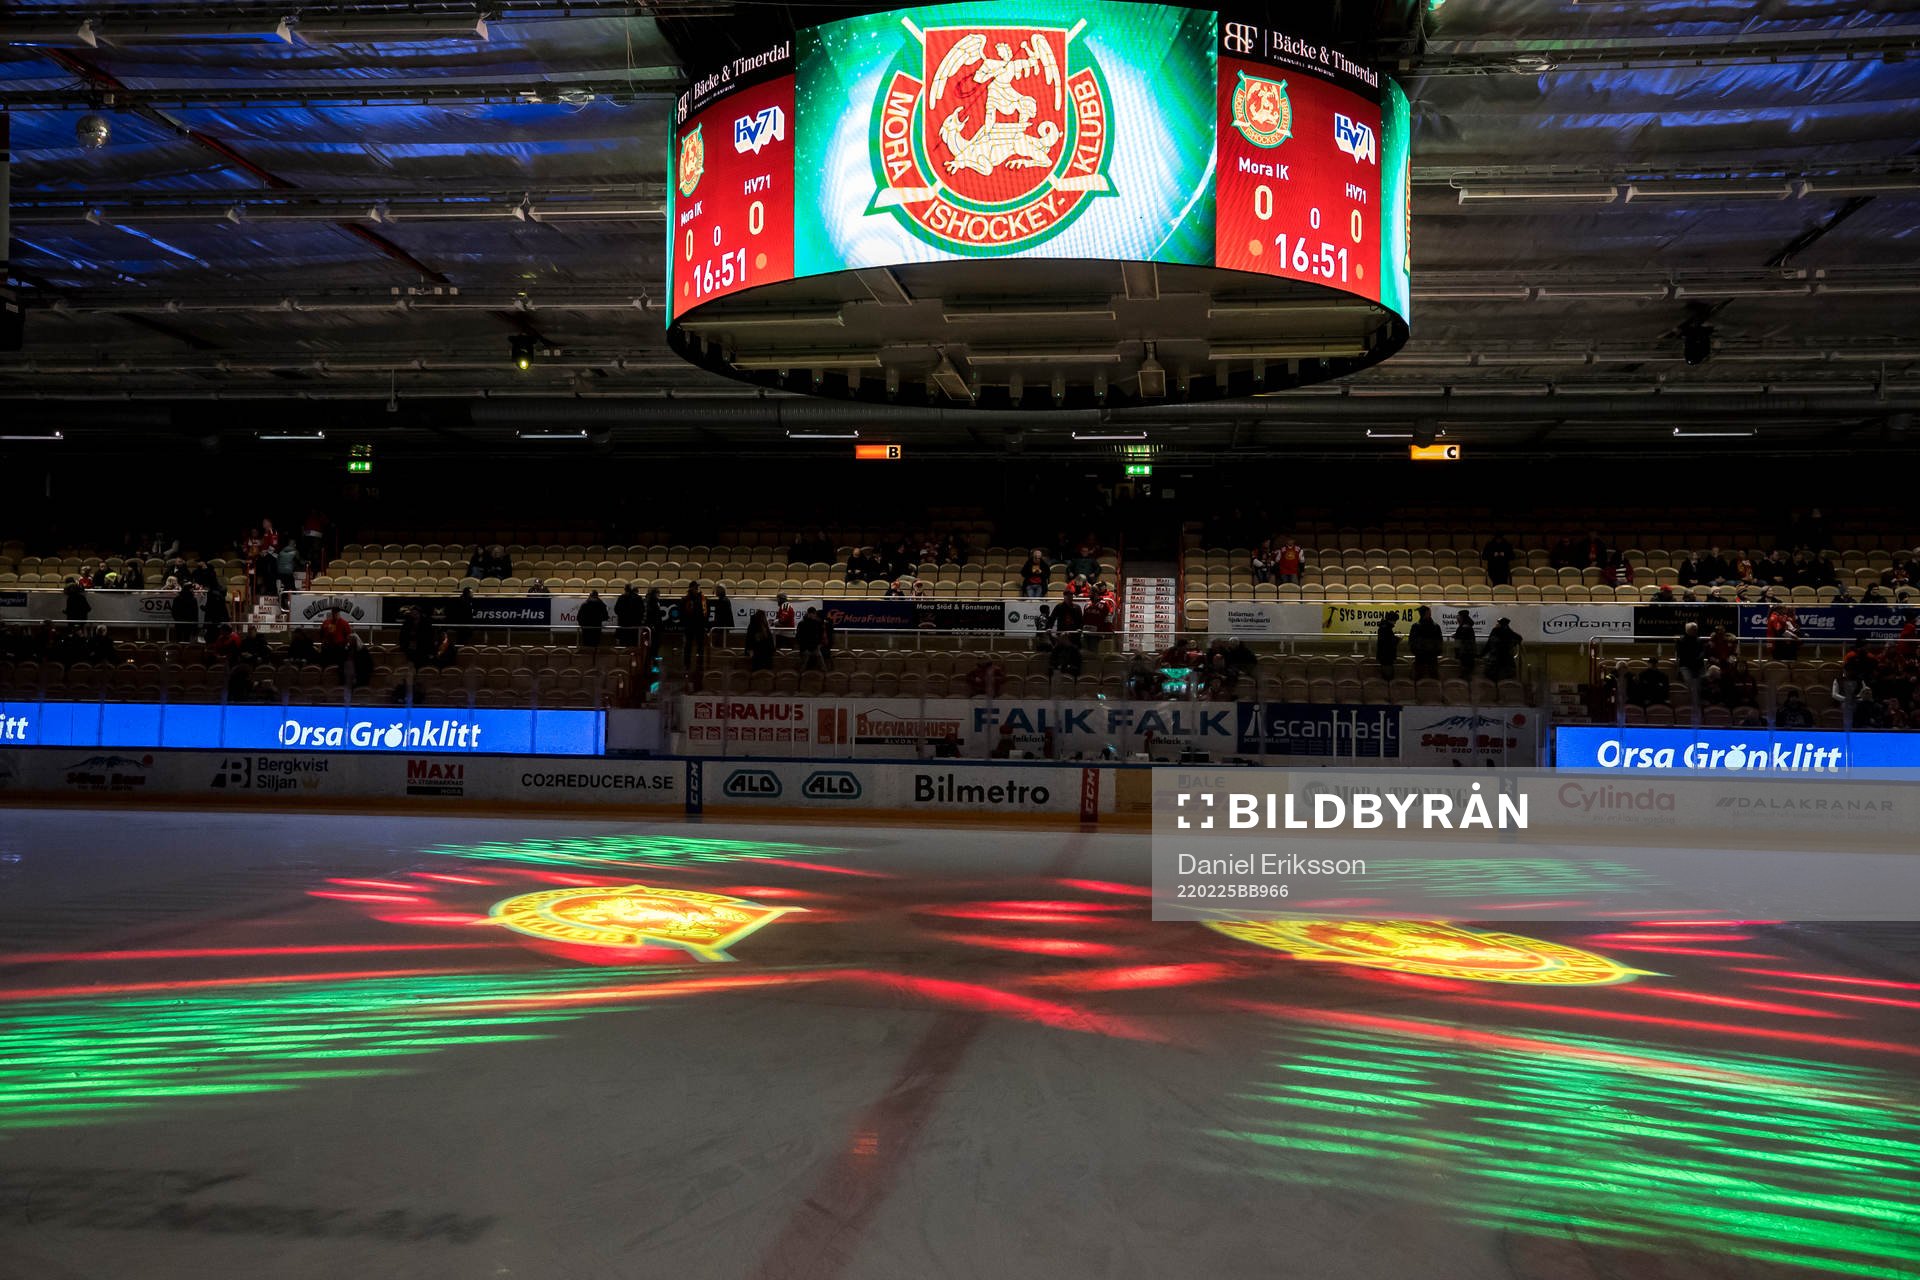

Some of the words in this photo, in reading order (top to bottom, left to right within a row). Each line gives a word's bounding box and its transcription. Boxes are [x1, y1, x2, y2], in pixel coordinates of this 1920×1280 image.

[694, 72, 720, 101] Bäcke
[721, 65, 731, 82] &
[732, 40, 790, 77] Timerdal
[1272, 31, 1317, 60] Bäcke
[1319, 46, 1330, 65] &
[1332, 50, 1379, 88] Timerdal
[884, 91, 914, 182] MORA
[1072, 78, 1103, 173] KLUBB
[1238, 157, 1273, 178] Mora
[1276, 163, 1290, 181] IK
[744, 174, 771, 196] HV71
[1345, 182, 1367, 205] HV71
[680, 208, 694, 227] Mora
[694, 200, 704, 215] IK
[1254, 185, 1273, 221] 0
[748, 200, 765, 236] 0
[1310, 207, 1321, 230] 0
[1351, 209, 1363, 244] 0
[685, 229, 694, 262] 0
[713, 225, 722, 247] 0
[1274, 233, 1349, 283] 16:51
[693, 247, 747, 298] 16:51
[888, 446, 899, 458] B
[1447, 446, 1457, 458] C
[1340, 608, 1355, 622] SYS
[1402, 608, 1413, 622] AB
[1800, 614, 1836, 628] Vägg
[716, 703, 804, 720] BRAHUS
[974, 708, 1096, 734] FALK
[1107, 708, 1232, 736] FALK
[279, 720, 342, 747] Orsa
[1272, 718, 1397, 739] scanmast
[258, 757, 328, 775] Bergkvist
[1597, 740, 1675, 768] Orsa
[257, 774, 297, 792] Siljan
[408, 760, 464, 779] MAXI
[521, 773, 674, 791] CO2REDUCERA.SE
[690, 761, 700, 807] CCM
[915, 774, 1050, 804] Bilmetro
[1086, 769, 1097, 814] CCM
[1558, 782, 1676, 811] Cylinda
[1738, 798, 1894, 811] DALAKRANAR
